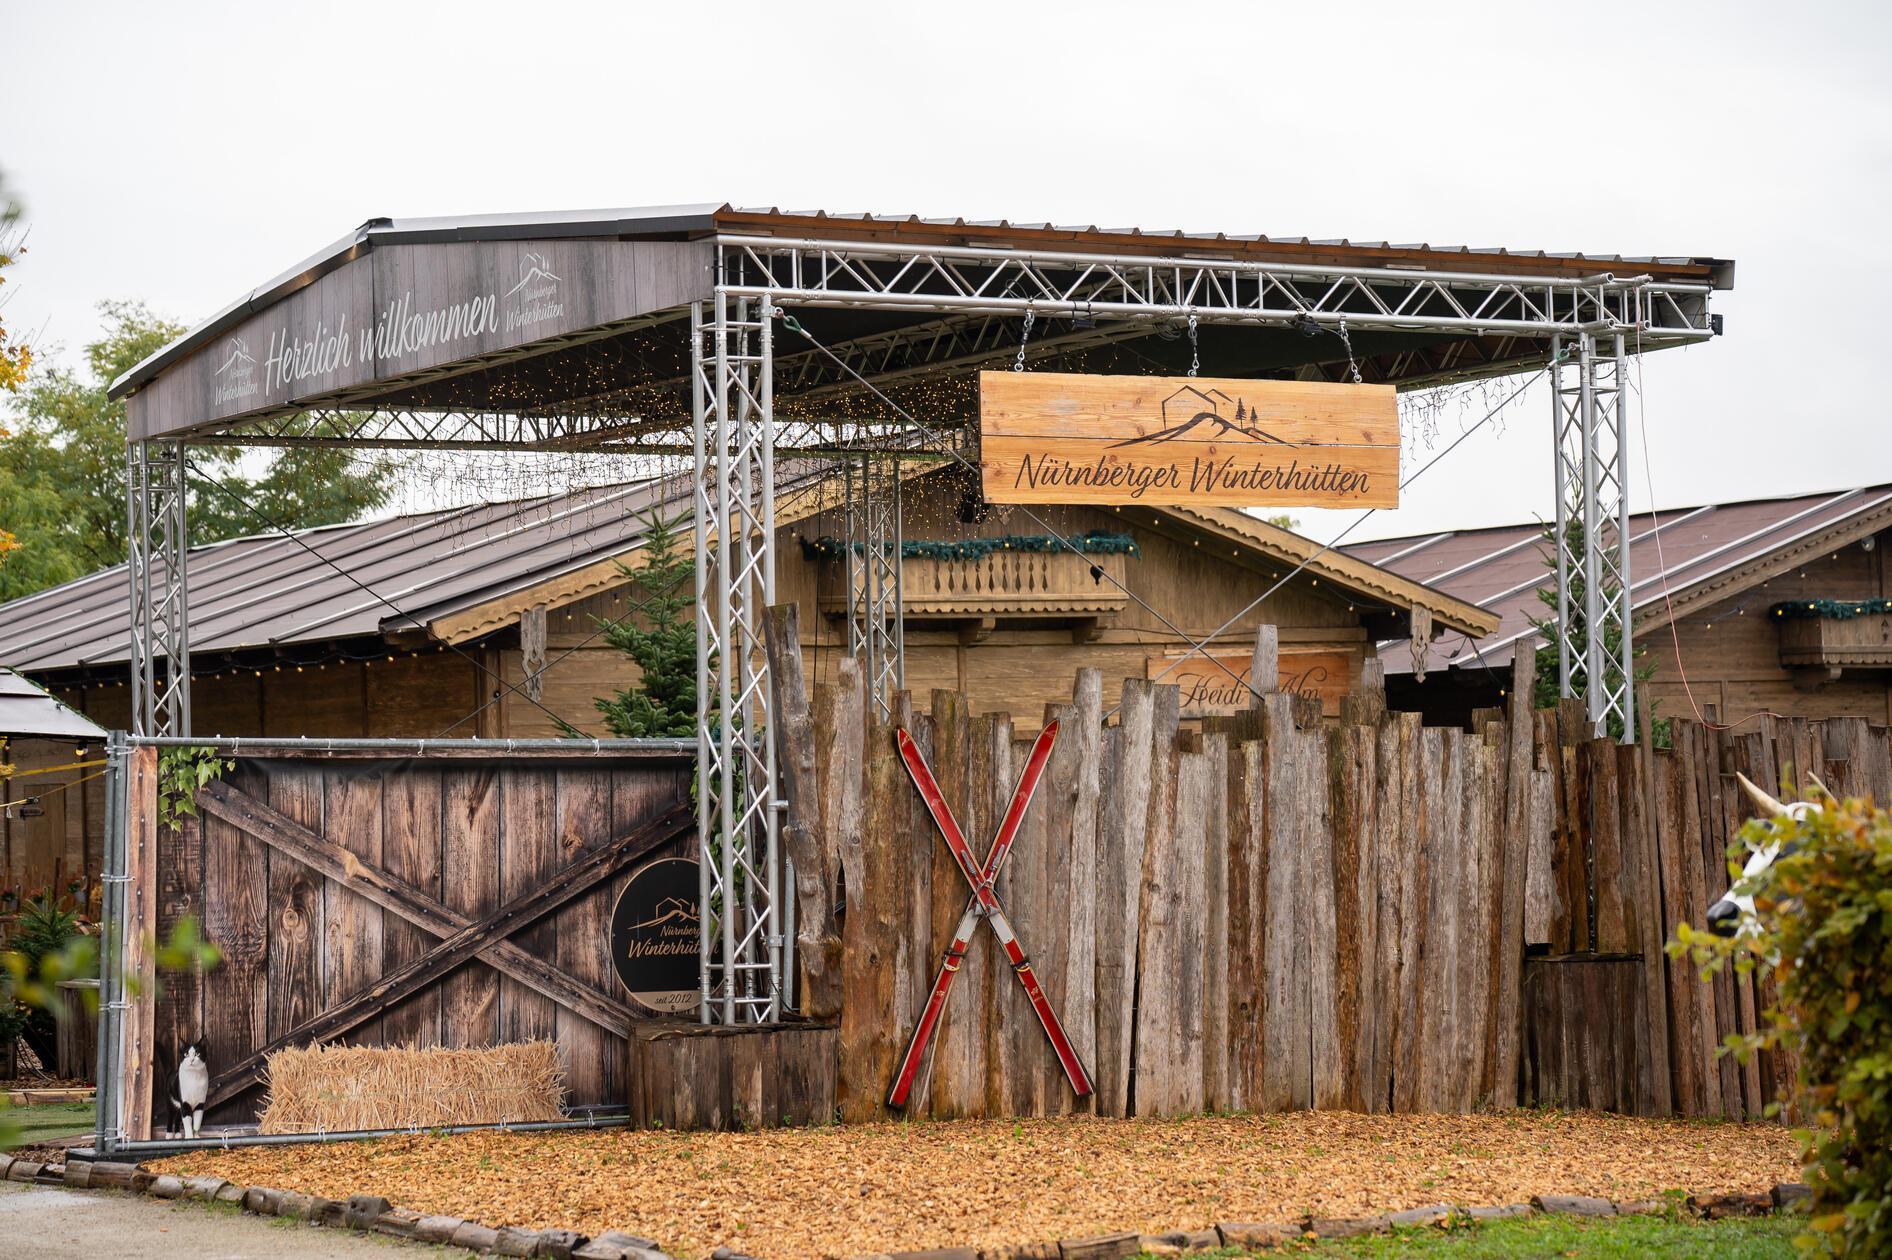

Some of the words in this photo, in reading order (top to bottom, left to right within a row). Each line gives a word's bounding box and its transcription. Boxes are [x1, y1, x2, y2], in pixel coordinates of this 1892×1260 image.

[505, 300, 565, 332] Winterhütten
[264, 313, 352, 397] Herzlich
[359, 291, 499, 364] willkommen
[1014, 453, 1182, 499] Nürnberger
[1189, 455, 1370, 495] Winterhütten
[660, 925, 701, 938] Nürnberg
[669, 993, 692, 1004] 2012
